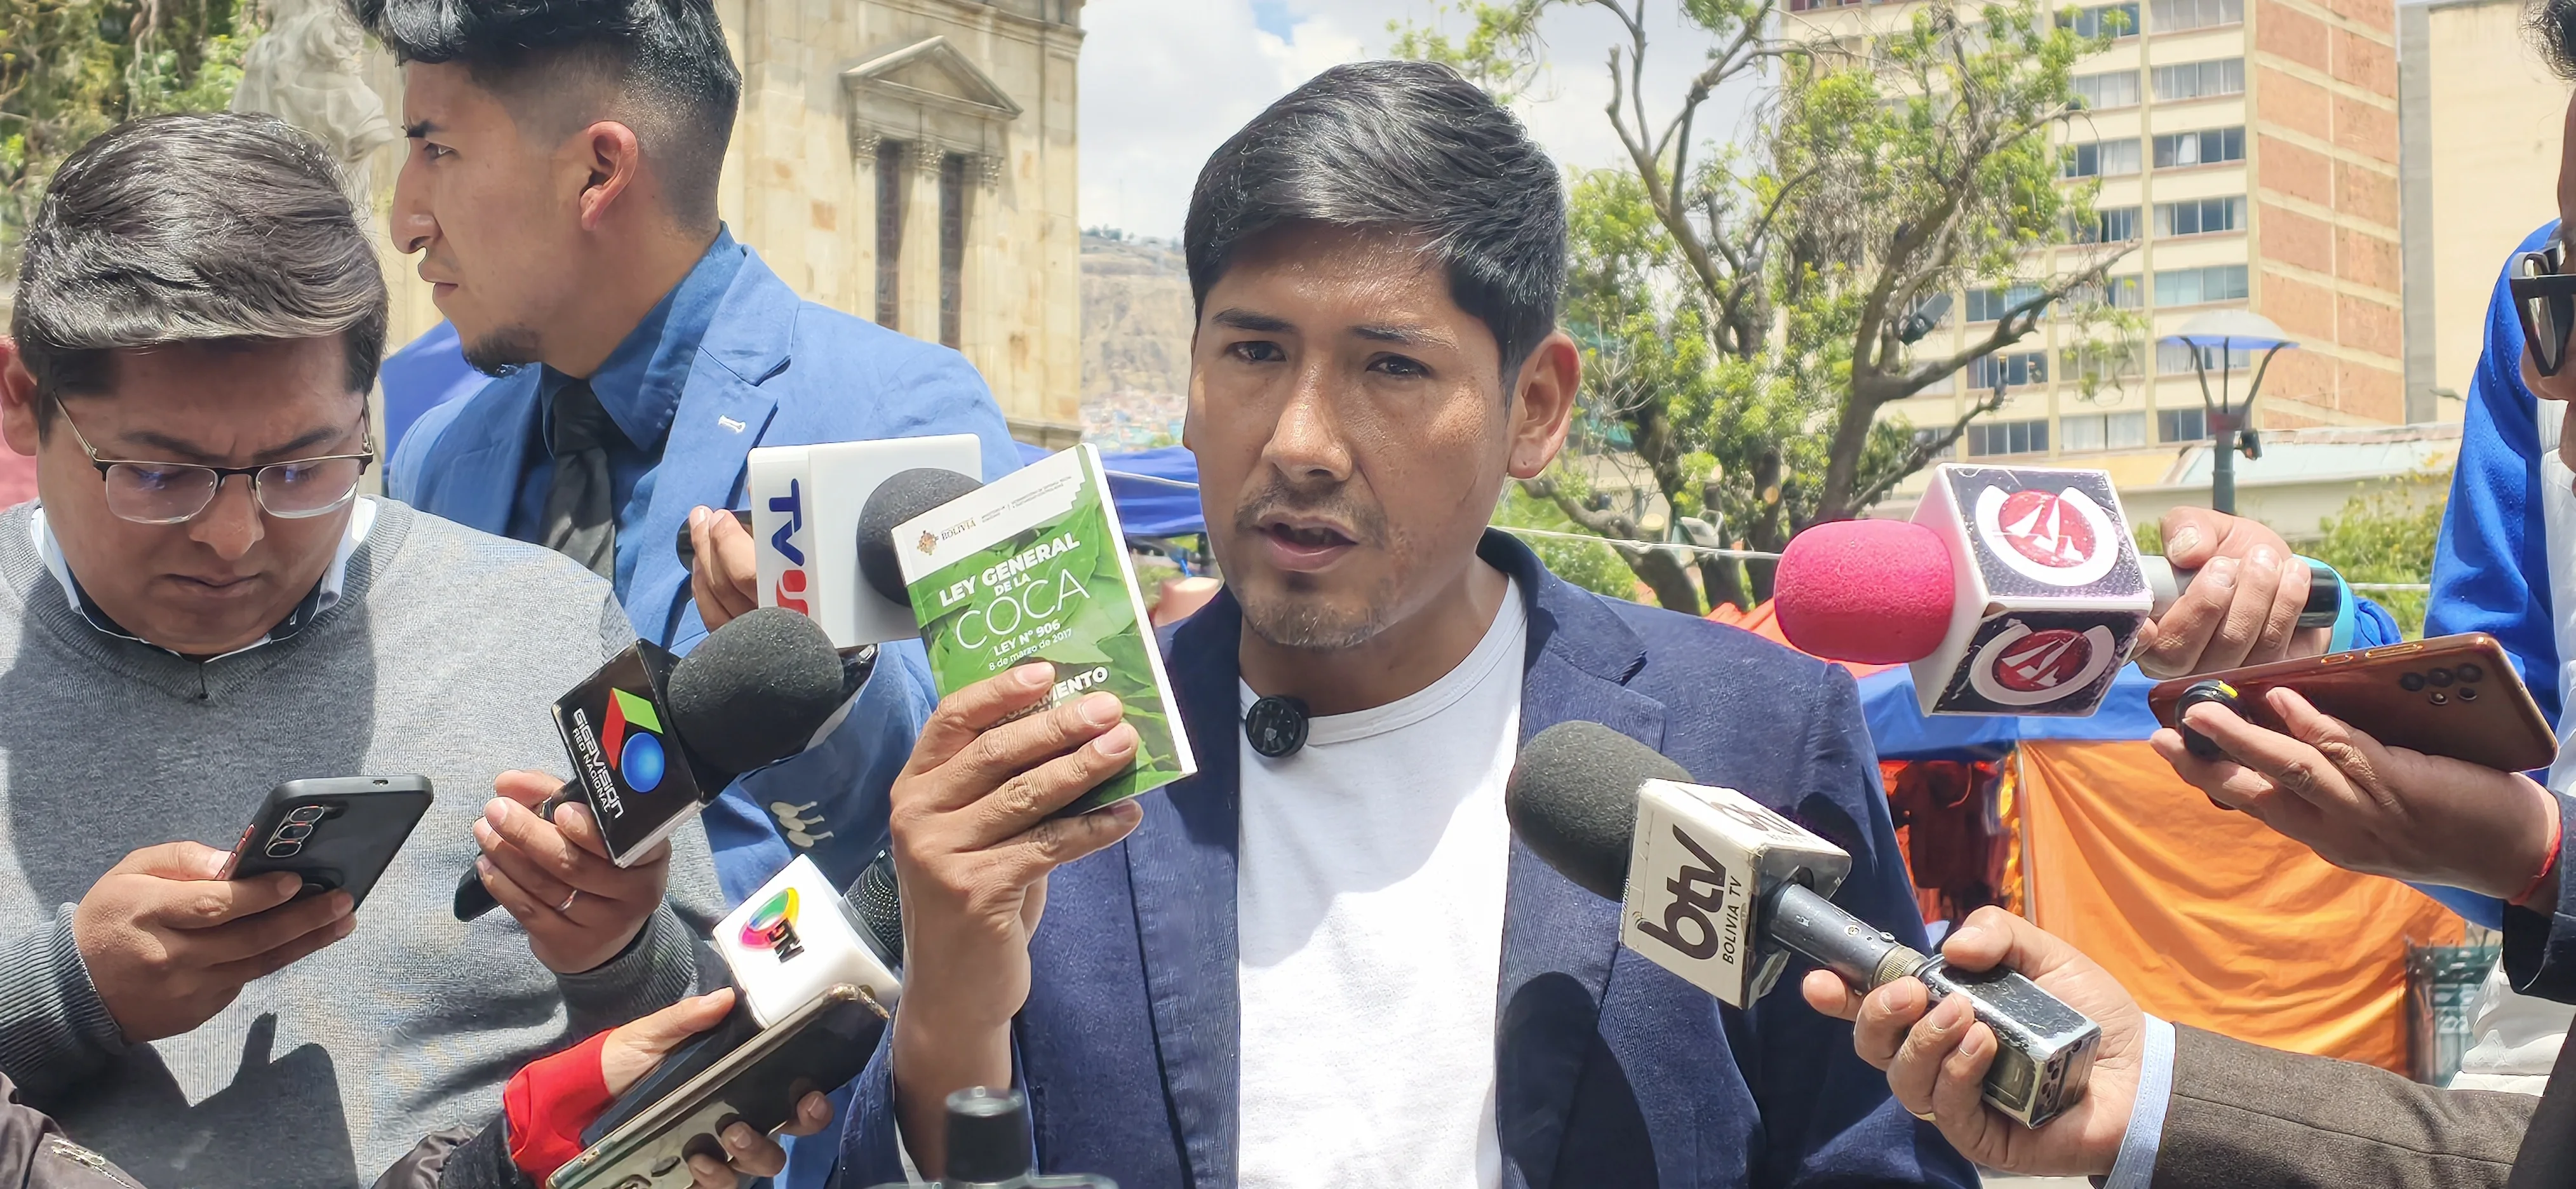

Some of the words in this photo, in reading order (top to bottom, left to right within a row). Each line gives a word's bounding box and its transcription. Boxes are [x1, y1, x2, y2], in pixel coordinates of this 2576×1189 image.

[941, 518, 977, 541] BOLIVIA
[939, 575, 977, 607] LEY
[981, 532, 1081, 587] GENERAL
[994, 582, 1012, 596] DE
[1014, 573, 1031, 588] LA
[956, 568, 1090, 649] COCA
[988, 662, 996, 671] 8
[996, 657, 1009, 668] de
[1010, 645, 1038, 662] marzo
[1038, 639, 1051, 649] de
[1052, 628, 1072, 643] 2017
[993, 637, 1016, 656] LEY
[1036, 619, 1061, 638] 906
[573, 727, 586, 752] RED
[584, 753, 610, 814] NACIONAL
[1637, 824, 1727, 960] btv
[1729, 875, 1741, 897] TV
[1722, 904, 1740, 965] BOLIVIA
